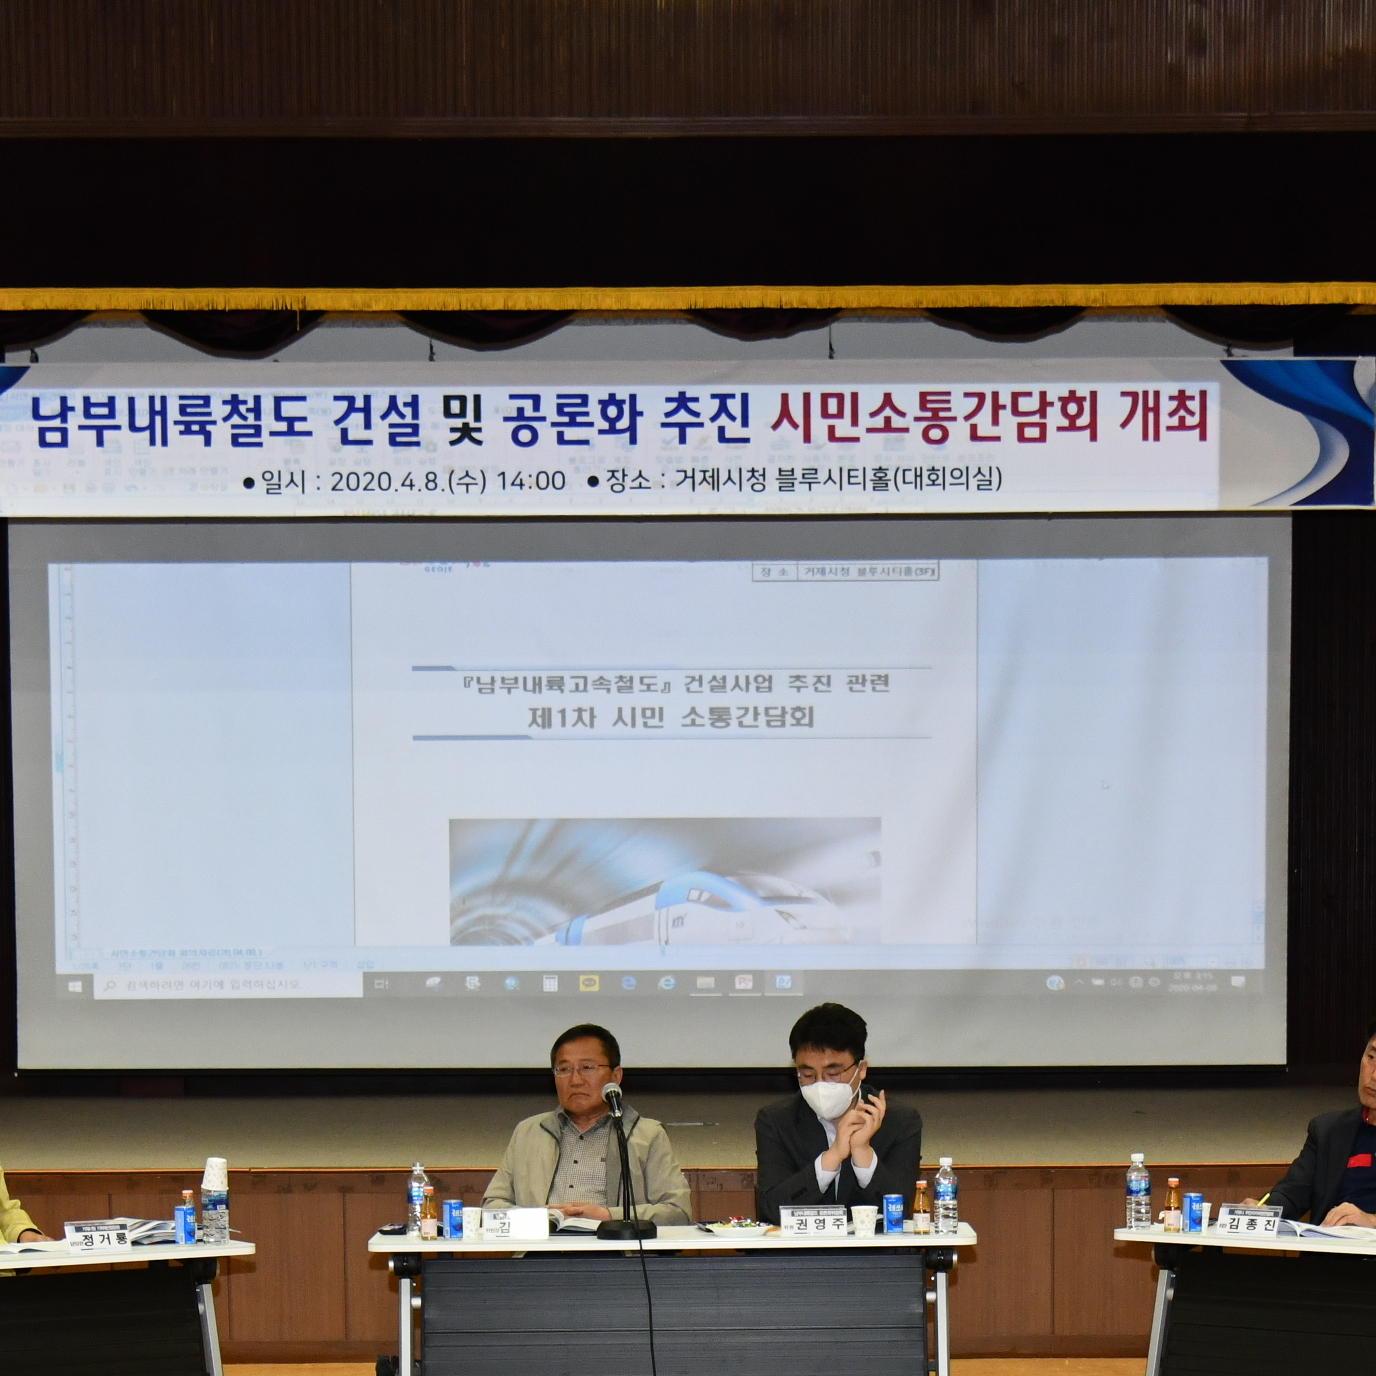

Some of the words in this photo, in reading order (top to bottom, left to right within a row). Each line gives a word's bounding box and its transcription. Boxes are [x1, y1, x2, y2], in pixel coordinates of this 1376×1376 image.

[31, 393, 314, 449] 남부내륙철도
[332, 393, 422, 449] 건설
[442, 393, 485, 448] 및
[502, 391, 645, 448] 공론화
[660, 390, 752, 446] 추진
[770, 389, 1099, 446] 시민소통간담회
[1119, 388, 1209, 443] 개최
[261, 469, 306, 495] 일시
[331, 468, 487, 496] 2020.4.8.(수)
[497, 470, 567, 492] 14:00
[606, 467, 652, 494] 장소
[675, 466, 767, 493] 거제시청
[775, 465, 1003, 493] 블루시티홀(대회의실)
[463, 674, 672, 695] 『남부내륙고속철도』
[684, 673, 774, 694] 건설사업
[788, 673, 832, 694] 추진
[846, 673, 891, 694] 관련
[527, 705, 597, 730] 제1차
[612, 705, 665, 730] 시민
[681, 705, 815, 730] 소통간담회
